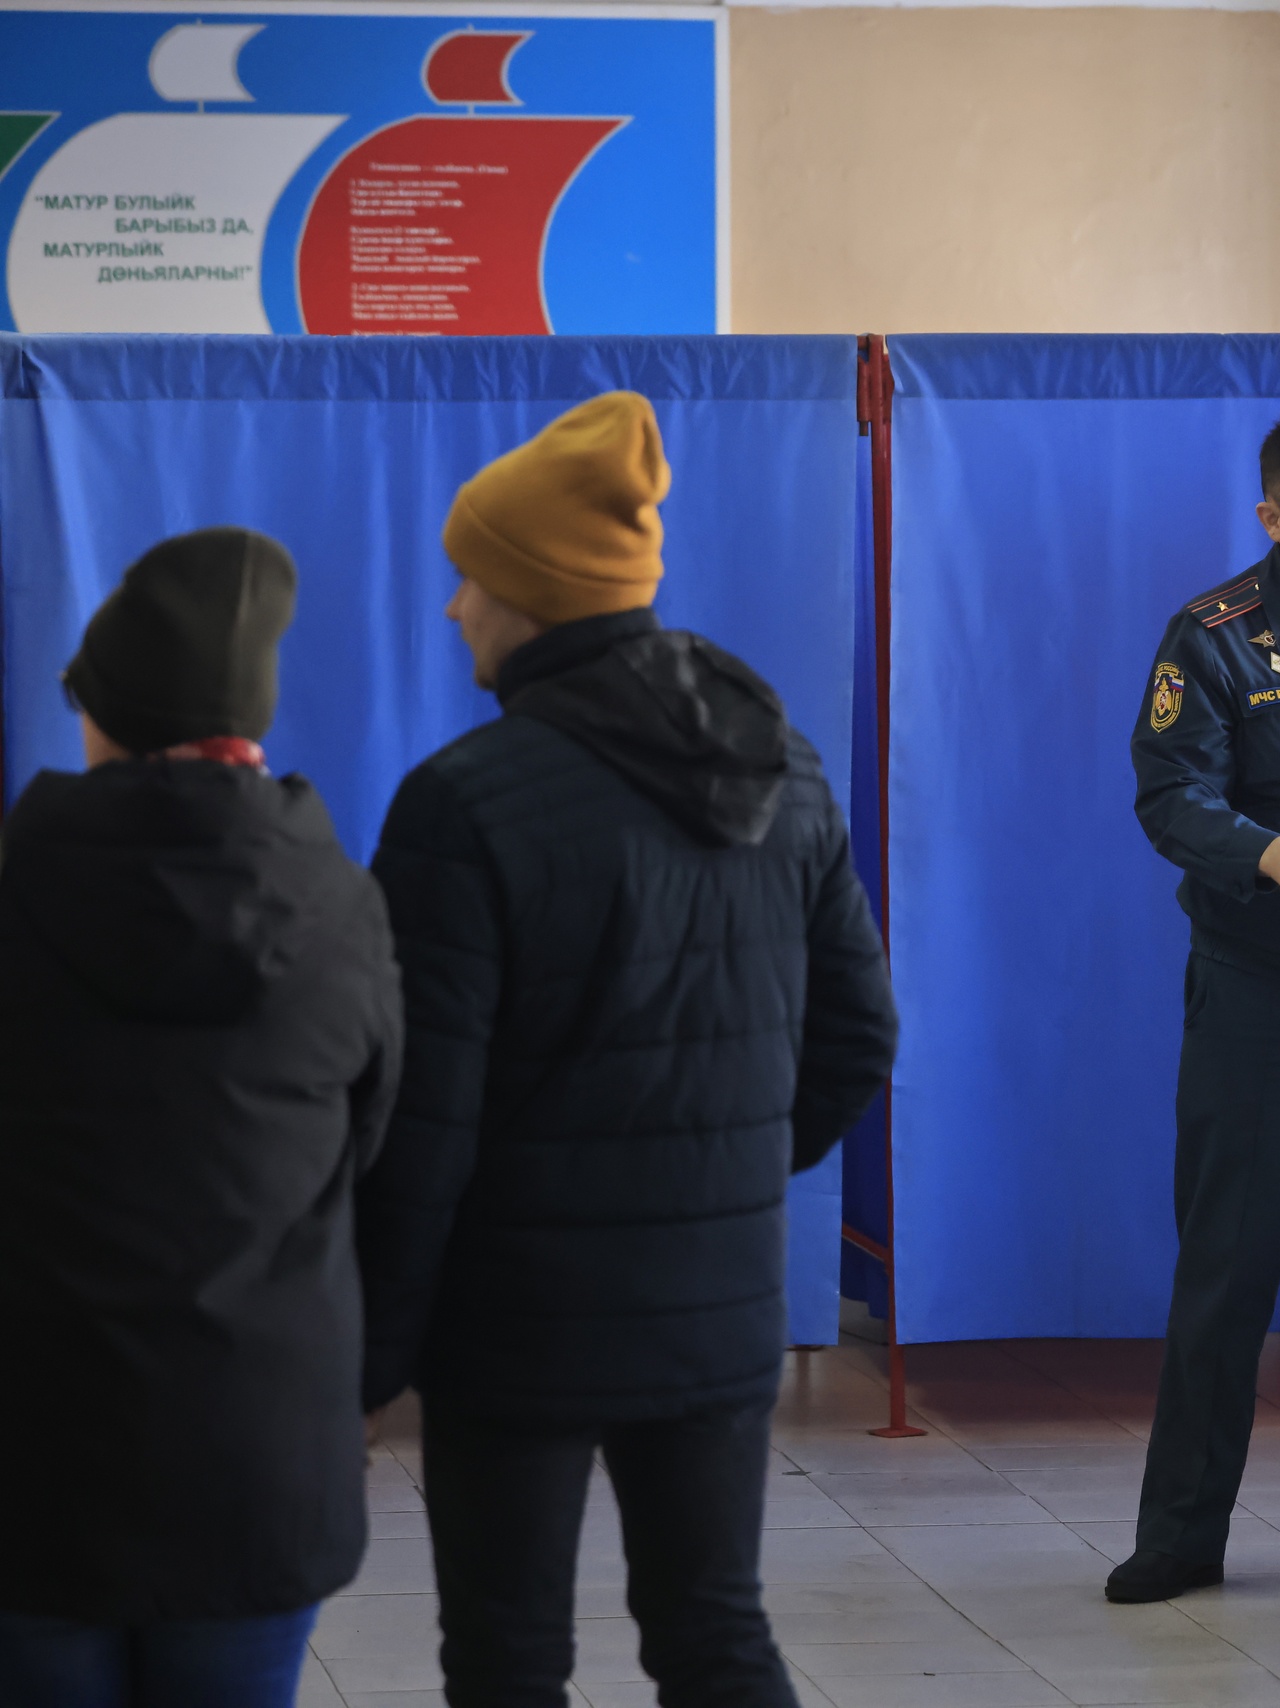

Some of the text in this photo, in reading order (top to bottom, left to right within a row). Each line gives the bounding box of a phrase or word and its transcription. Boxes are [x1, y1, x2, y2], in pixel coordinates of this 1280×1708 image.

[114, 192, 196, 211] БУЛЫЙК
[114, 217, 217, 234] БАРЫБЫЗ
[43, 239, 165, 258] МАТУРЛЫЙК
[1249, 690, 1275, 706] МЧС
